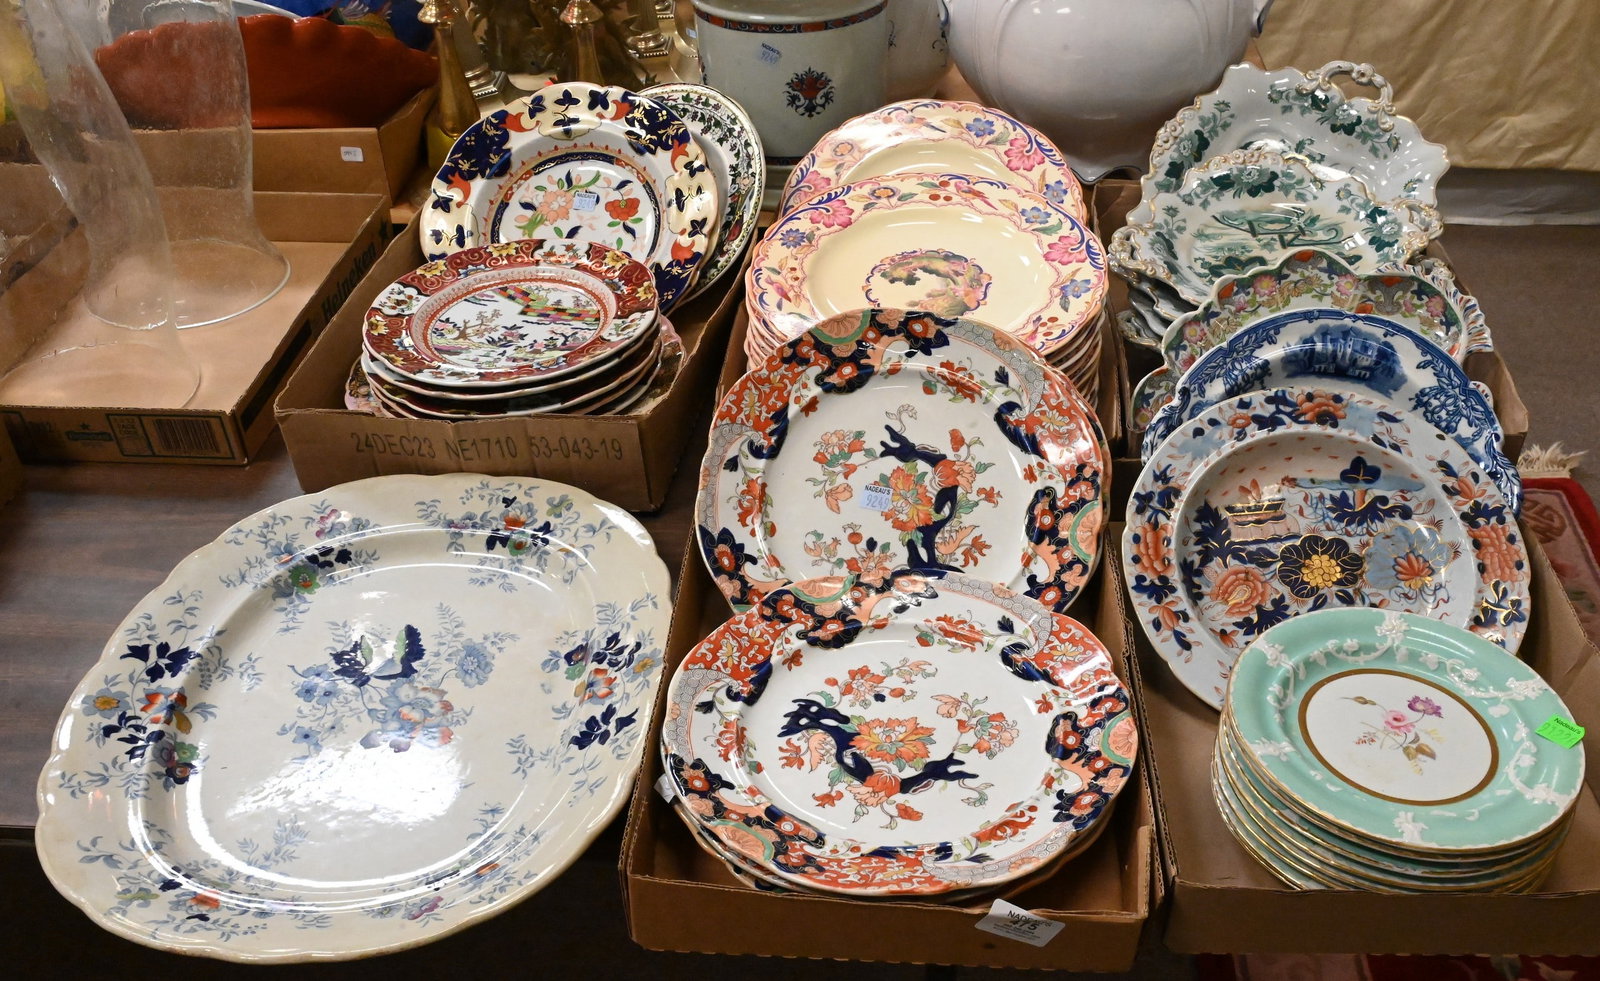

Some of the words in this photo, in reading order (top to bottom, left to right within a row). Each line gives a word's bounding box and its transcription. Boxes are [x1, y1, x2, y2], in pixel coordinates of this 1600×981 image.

[321, 241, 377, 320] Heineken
[351, 432, 437, 459] 24DEC23
[444, 436, 518, 461] NE1710
[529, 437, 623, 461] 53-043-19
[865, 485, 890, 495] NADEAU'S
[1554, 718, 1581, 734] Nadeau's
